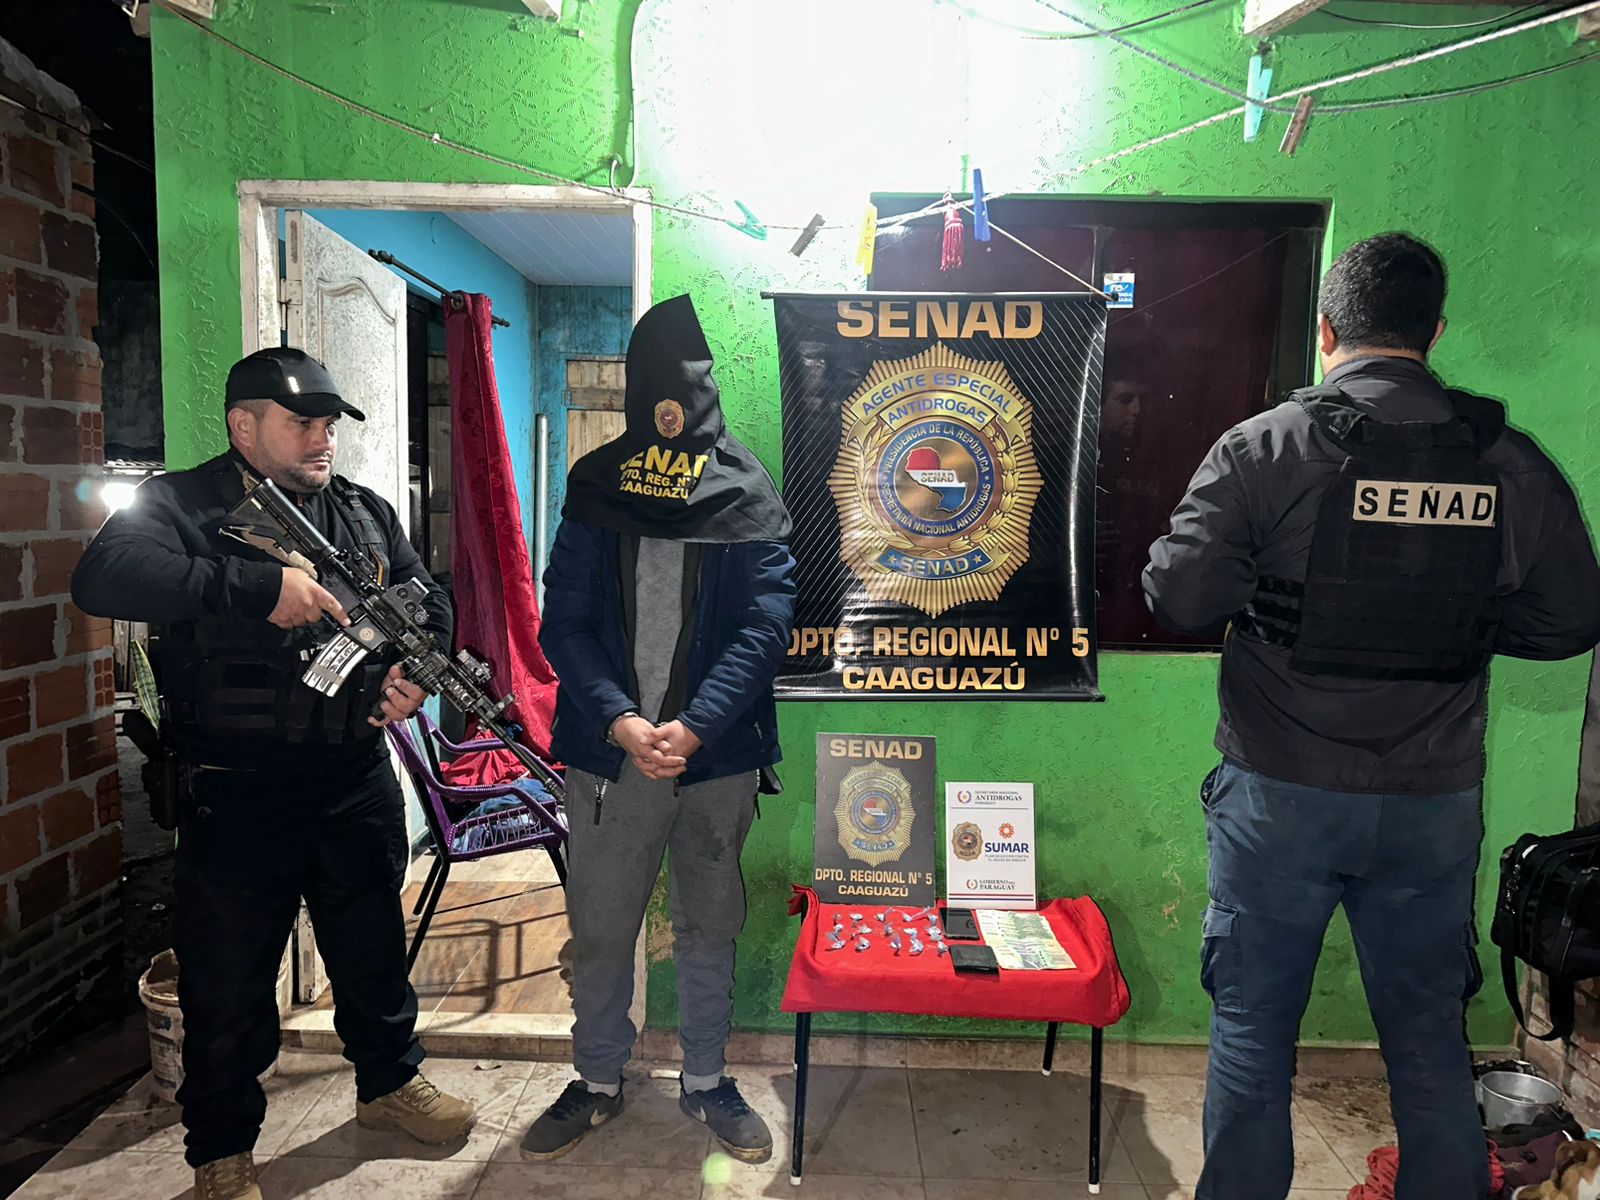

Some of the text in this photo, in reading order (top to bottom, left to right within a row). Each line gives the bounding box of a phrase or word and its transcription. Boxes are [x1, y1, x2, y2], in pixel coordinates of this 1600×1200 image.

[837, 300, 1043, 339] SENAD
[862, 372, 1013, 416] AGENTE ESPECIAL
[888, 397, 988, 425] ANTIDROGAS
[884, 423, 990, 473] PRESIDENCIA DE LA REPÚBLICA
[645, 472, 674, 487] REG.
[920, 472, 955, 483] SENAD
[913, 522, 957, 534] NACIONAL
[956, 483, 991, 529] ANTIDROGAS
[1358, 486, 1493, 521] SENAD
[900, 555, 969, 576] SENAD
[873, 627, 1016, 657] REGIONAL
[1072, 627, 1089, 658] 5
[842, 661, 1026, 691] CAAGUAZÚ
[830, 738, 923, 760] SENAD
[985, 842, 1029, 853] SUMAR
[815, 868, 847, 882] DPTO.
[850, 869, 905, 884] REGIONAL
[925, 872, 933, 886] 5
[838, 884, 909, 897] CAAGUAZÚ
